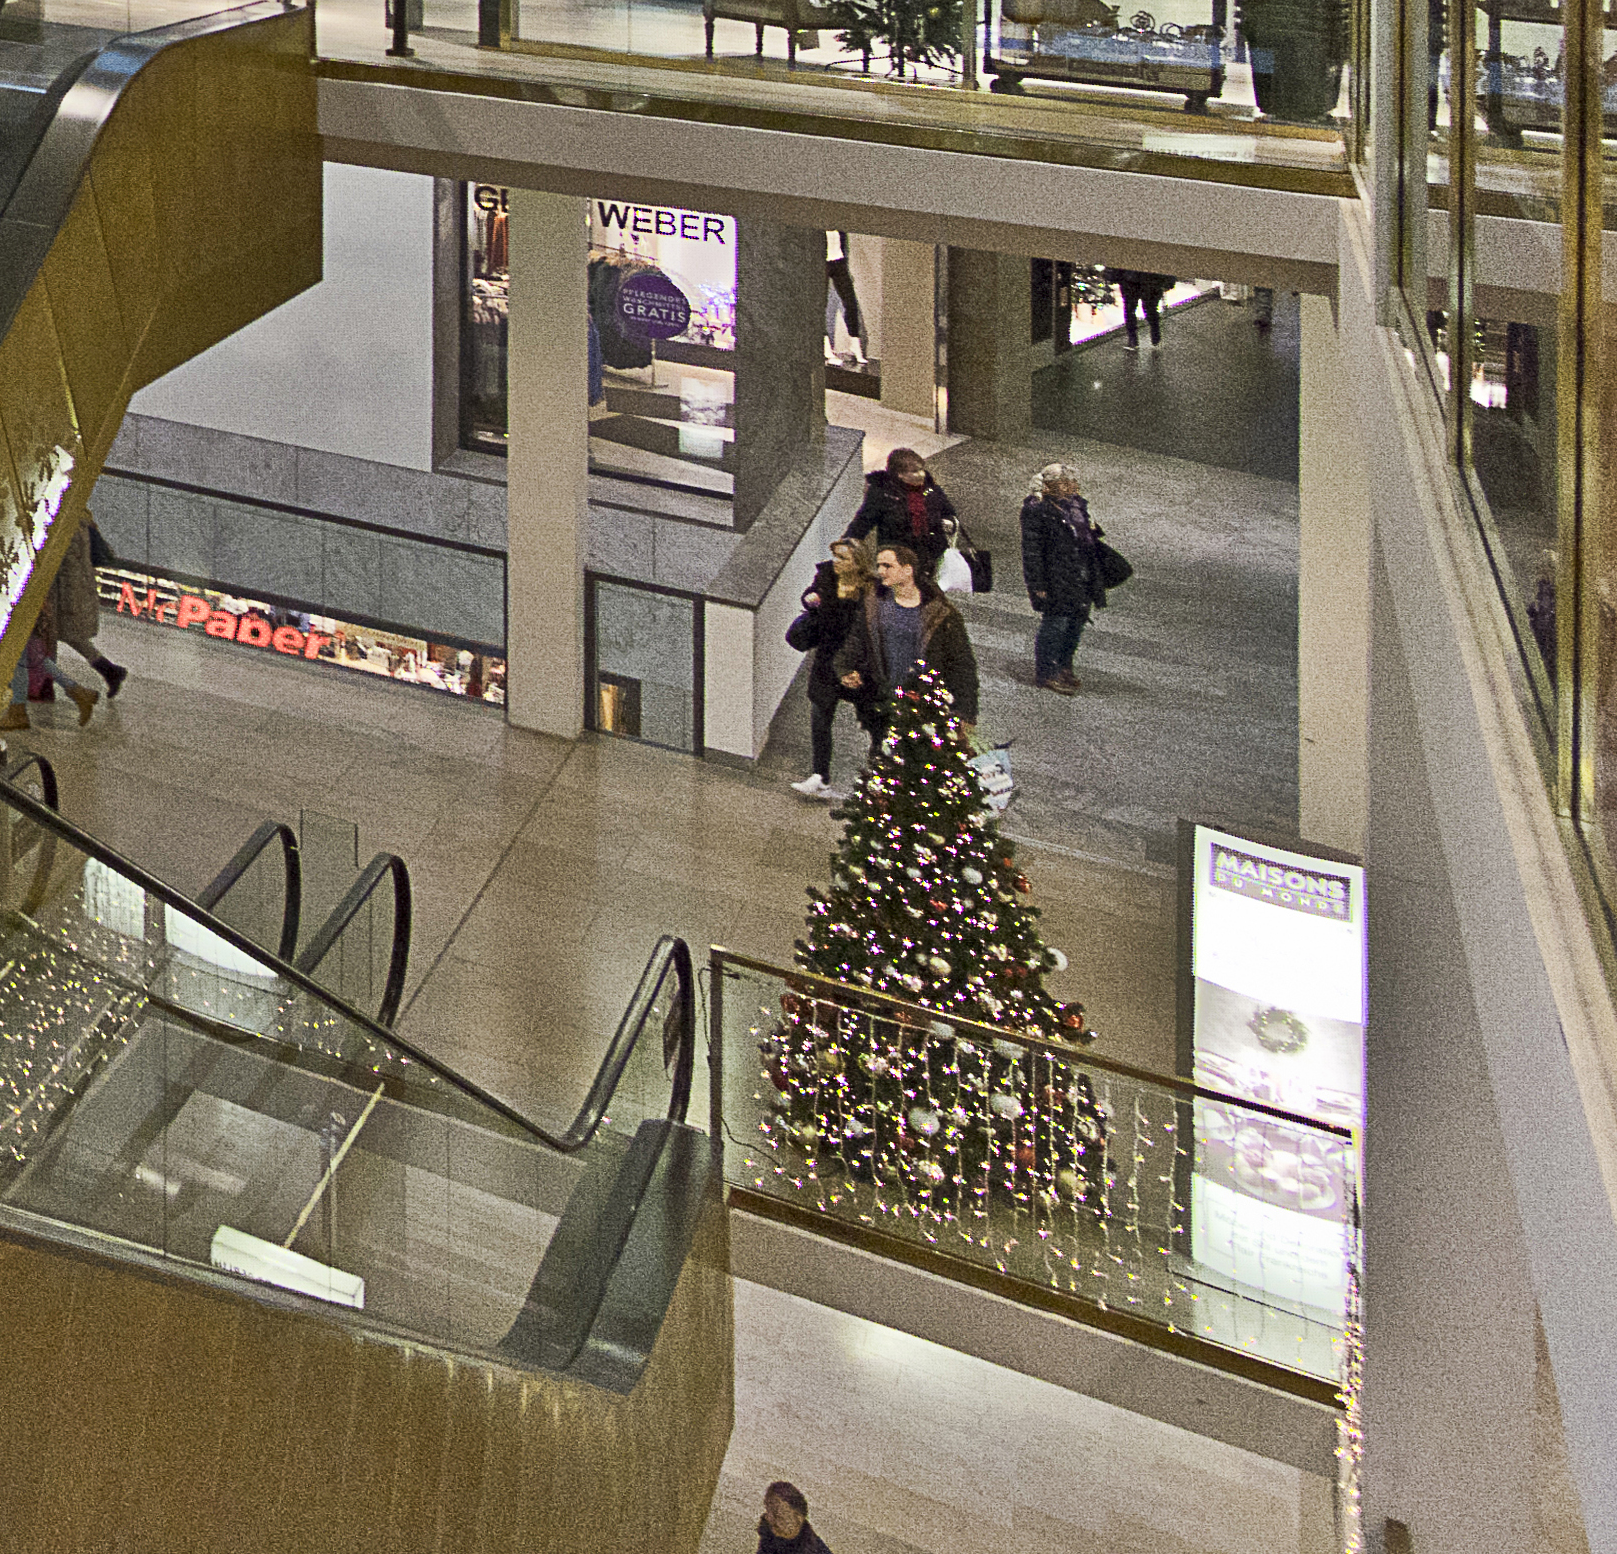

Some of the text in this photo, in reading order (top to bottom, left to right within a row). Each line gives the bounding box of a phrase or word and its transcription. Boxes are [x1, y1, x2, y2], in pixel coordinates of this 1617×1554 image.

[597, 201, 726, 245] WEBER
[623, 303, 686, 324] GRATIS
[1215, 871, 1345, 914] DU MONDE
[1216, 851, 1346, 901] MAISONS
